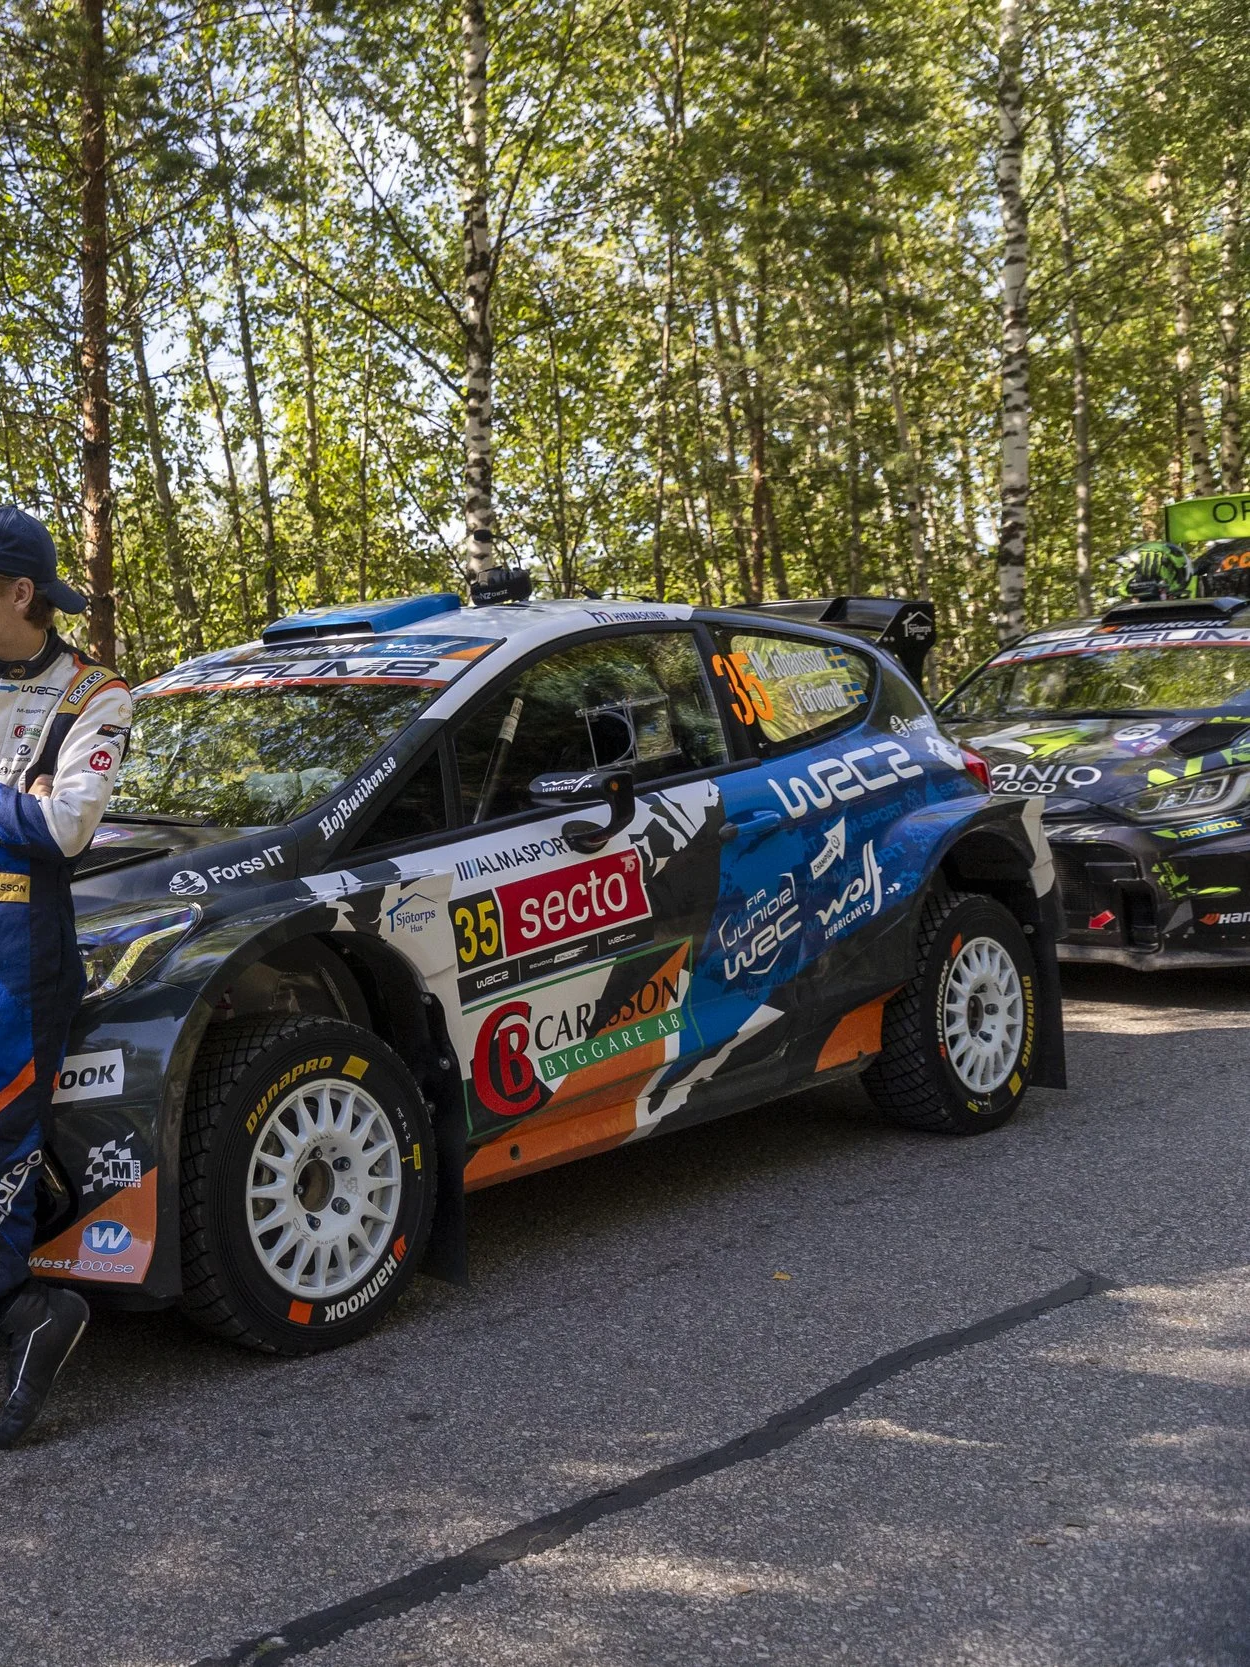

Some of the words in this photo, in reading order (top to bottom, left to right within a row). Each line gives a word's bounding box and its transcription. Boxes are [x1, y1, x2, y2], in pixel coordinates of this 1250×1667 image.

[613, 611, 666, 622] HYRMASKINER
[68, 671, 105, 705] sparco
[767, 741, 923, 819] WRC2
[1179, 819, 1242, 838] RAVENOL
[207, 854, 265, 884] Forss
[265, 846, 285, 867] IT
[813, 847, 833, 873] CHAMPION
[520, 870, 628, 940] secto
[745, 889, 766, 910] FIA
[396, 908, 436, 927] Sjötorps
[410, 923, 423, 933] Hus
[727, 887, 793, 948] JUNIOR
[824, 900, 871, 940] LUBRICANTS
[454, 899, 499, 963] 35
[724, 904, 801, 981] WRC
[476, 970, 509, 989] WRC2
[544, 1026, 646, 1077] BYGGARE
[657, 1013, 680, 1035] AB
[114, 1181, 141, 1189] POLAND
[91, 1225, 128, 1250] W
[28, 1256, 135, 1274] West2000.se
